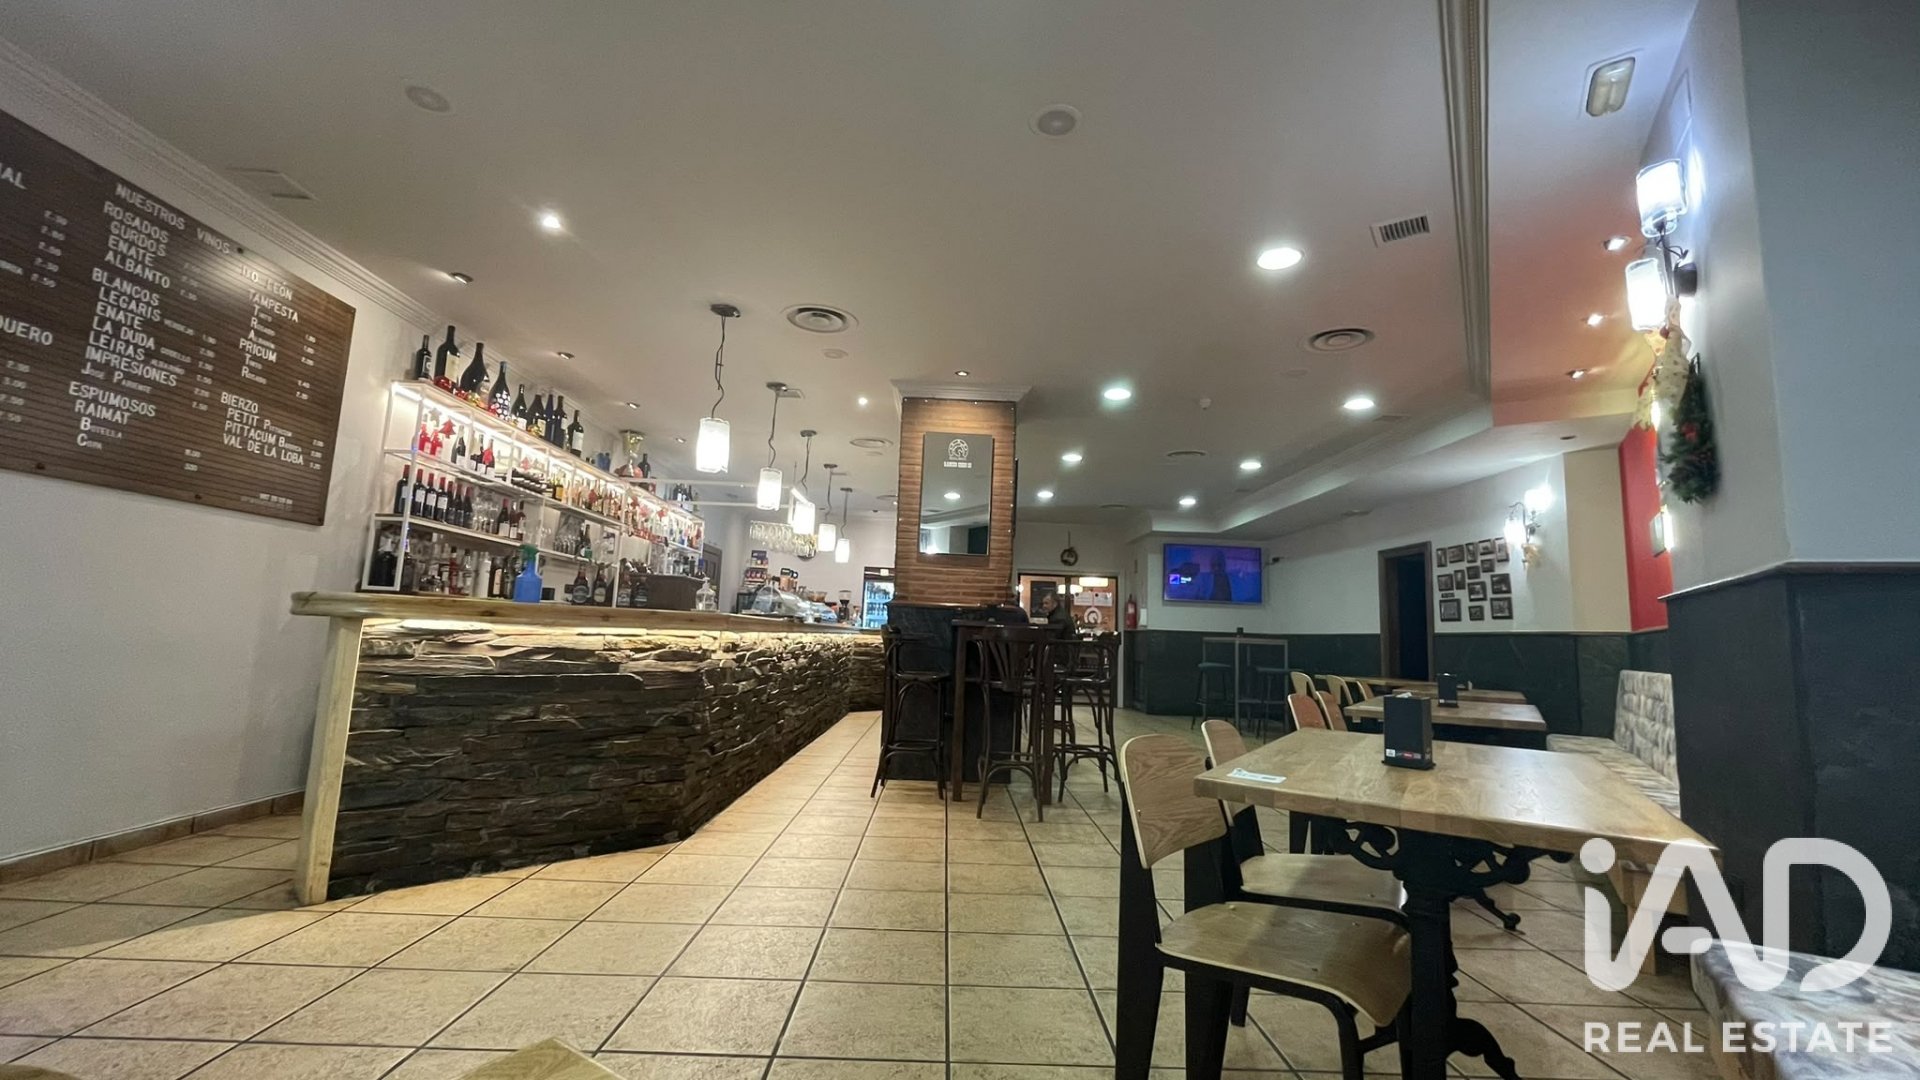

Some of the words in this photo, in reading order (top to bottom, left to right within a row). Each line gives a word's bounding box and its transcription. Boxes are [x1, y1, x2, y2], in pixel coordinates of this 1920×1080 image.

[103, 201, 170, 244] ROSADOS
[115, 182, 187, 230] NUESTROS
[196, 227, 231, 255] VINOS
[107, 234, 156, 267] ENATE
[110, 220, 167, 257] GURDOS
[92, 267, 160, 306] BLANCOS
[104, 249, 171, 289] ALBANTO
[96, 301, 144, 331] ENATE
[98, 286, 162, 322] LEGARIS
[248, 287, 299, 323] TAMPESTA
[89, 330, 146, 362] LEIRAS
[93, 315, 113, 335] LA
[120, 326, 156, 351] DUDA
[239, 337, 277, 363] PRICUM
[85, 345, 178, 388] IMPRESIONES
[69, 381, 157, 417] ESPUMOSOS
[74, 399, 131, 425] RAIMAT
[220, 391, 259, 413] BIERZO
[226, 407, 260, 427] PETIT
[223, 433, 243, 450] VAL
[247, 440, 261, 454] DE
[263, 445, 277, 459] LA
[281, 449, 304, 466] LOBA
[224, 420, 277, 445] PITTACUM
